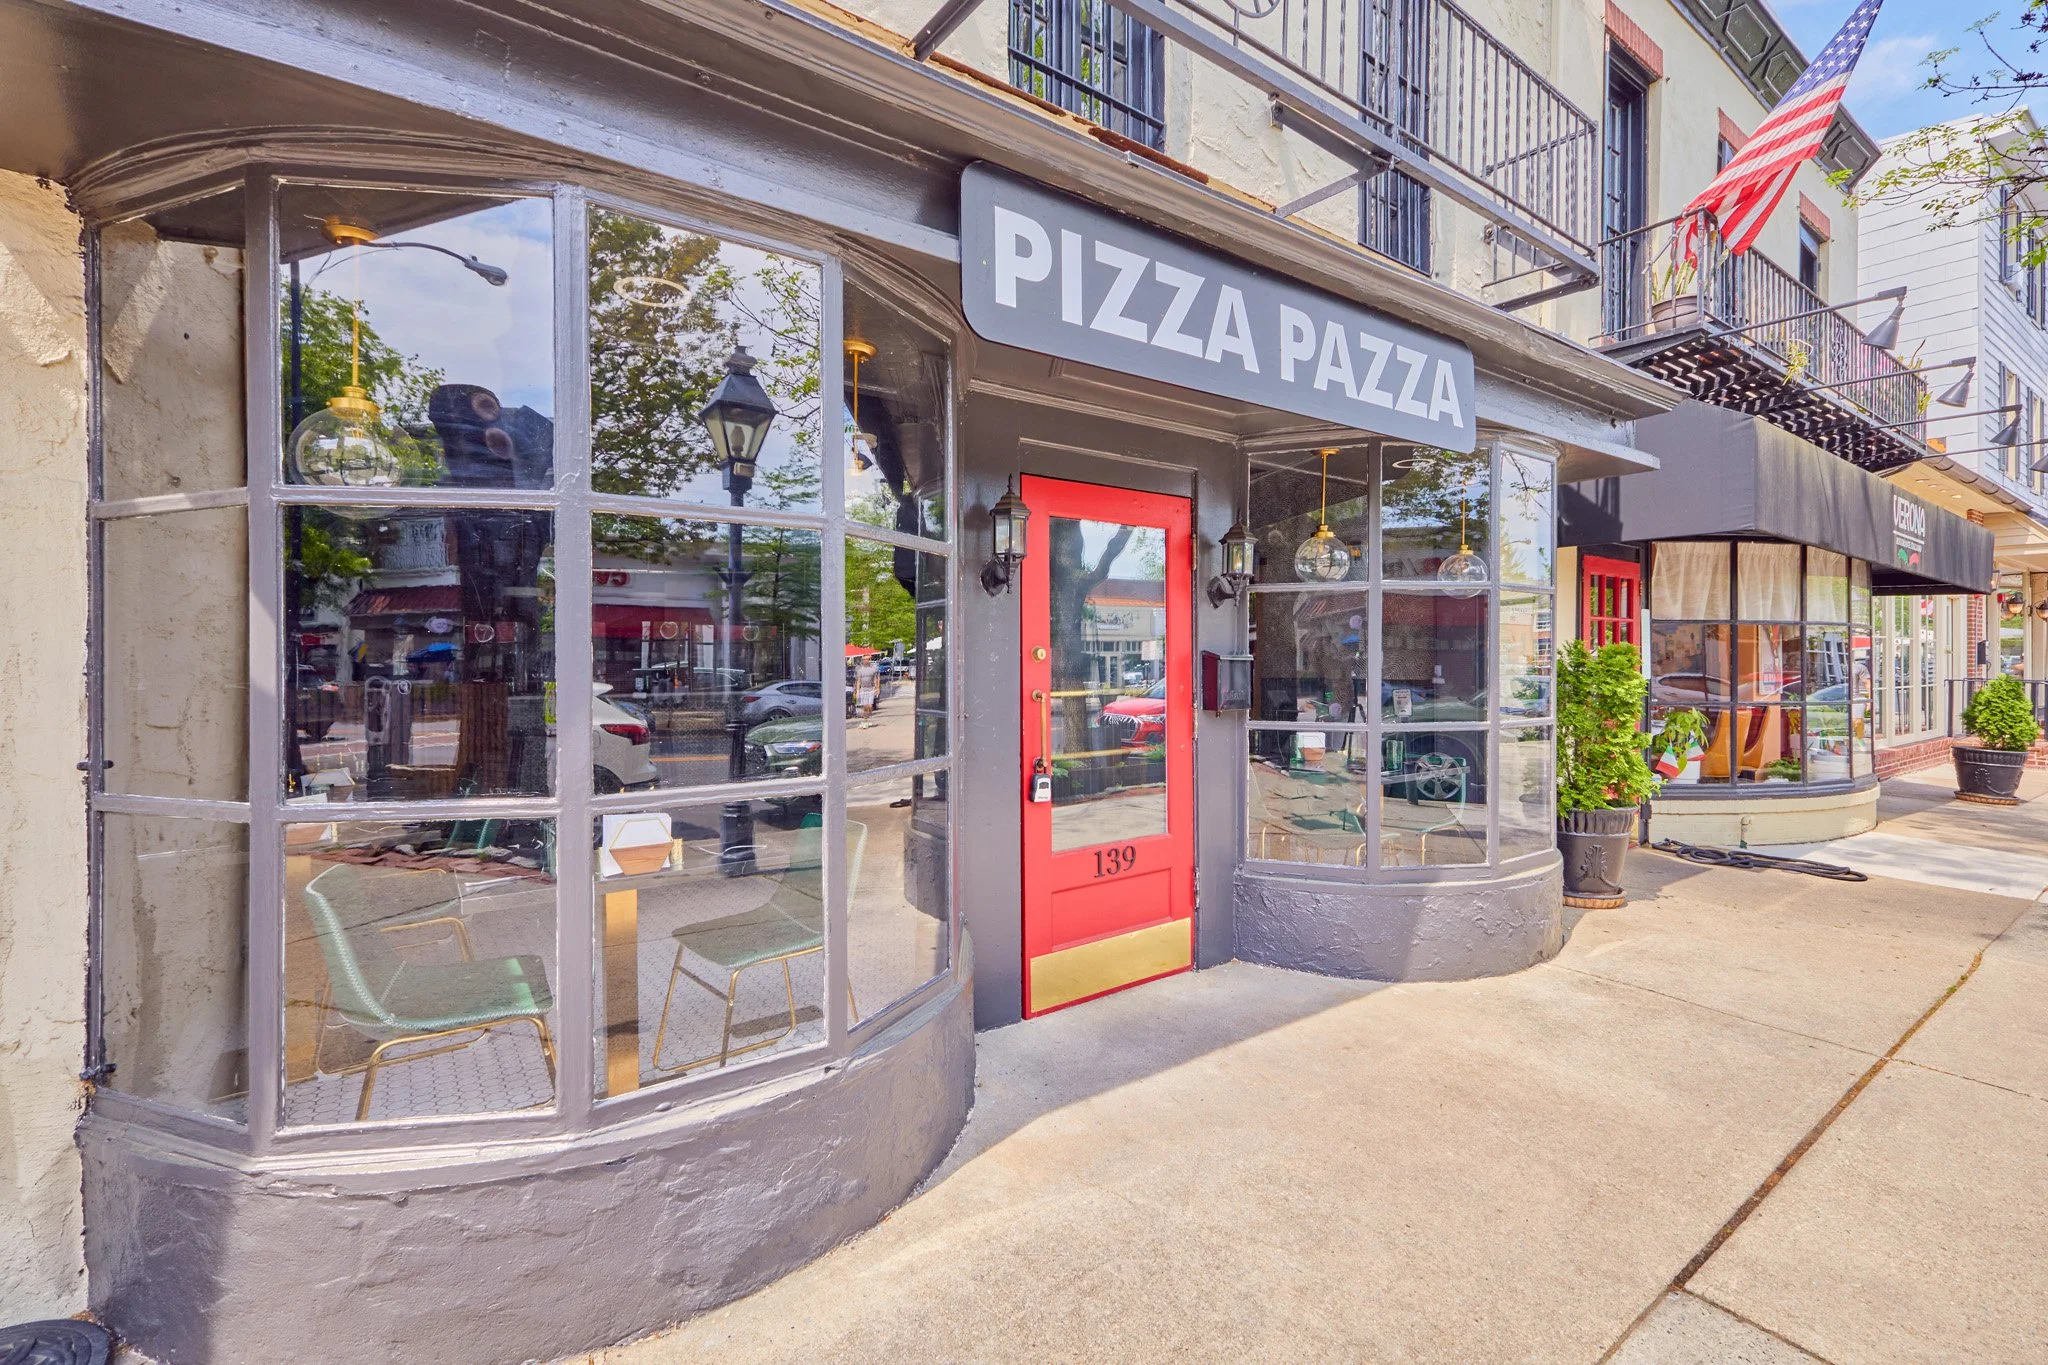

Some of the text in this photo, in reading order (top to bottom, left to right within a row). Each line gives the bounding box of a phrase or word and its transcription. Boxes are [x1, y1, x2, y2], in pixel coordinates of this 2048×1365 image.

[994, 205, 1464, 428] PIZZA PAZZA
[1893, 494, 1925, 537] VERONA
[1094, 845, 1136, 878] 139
